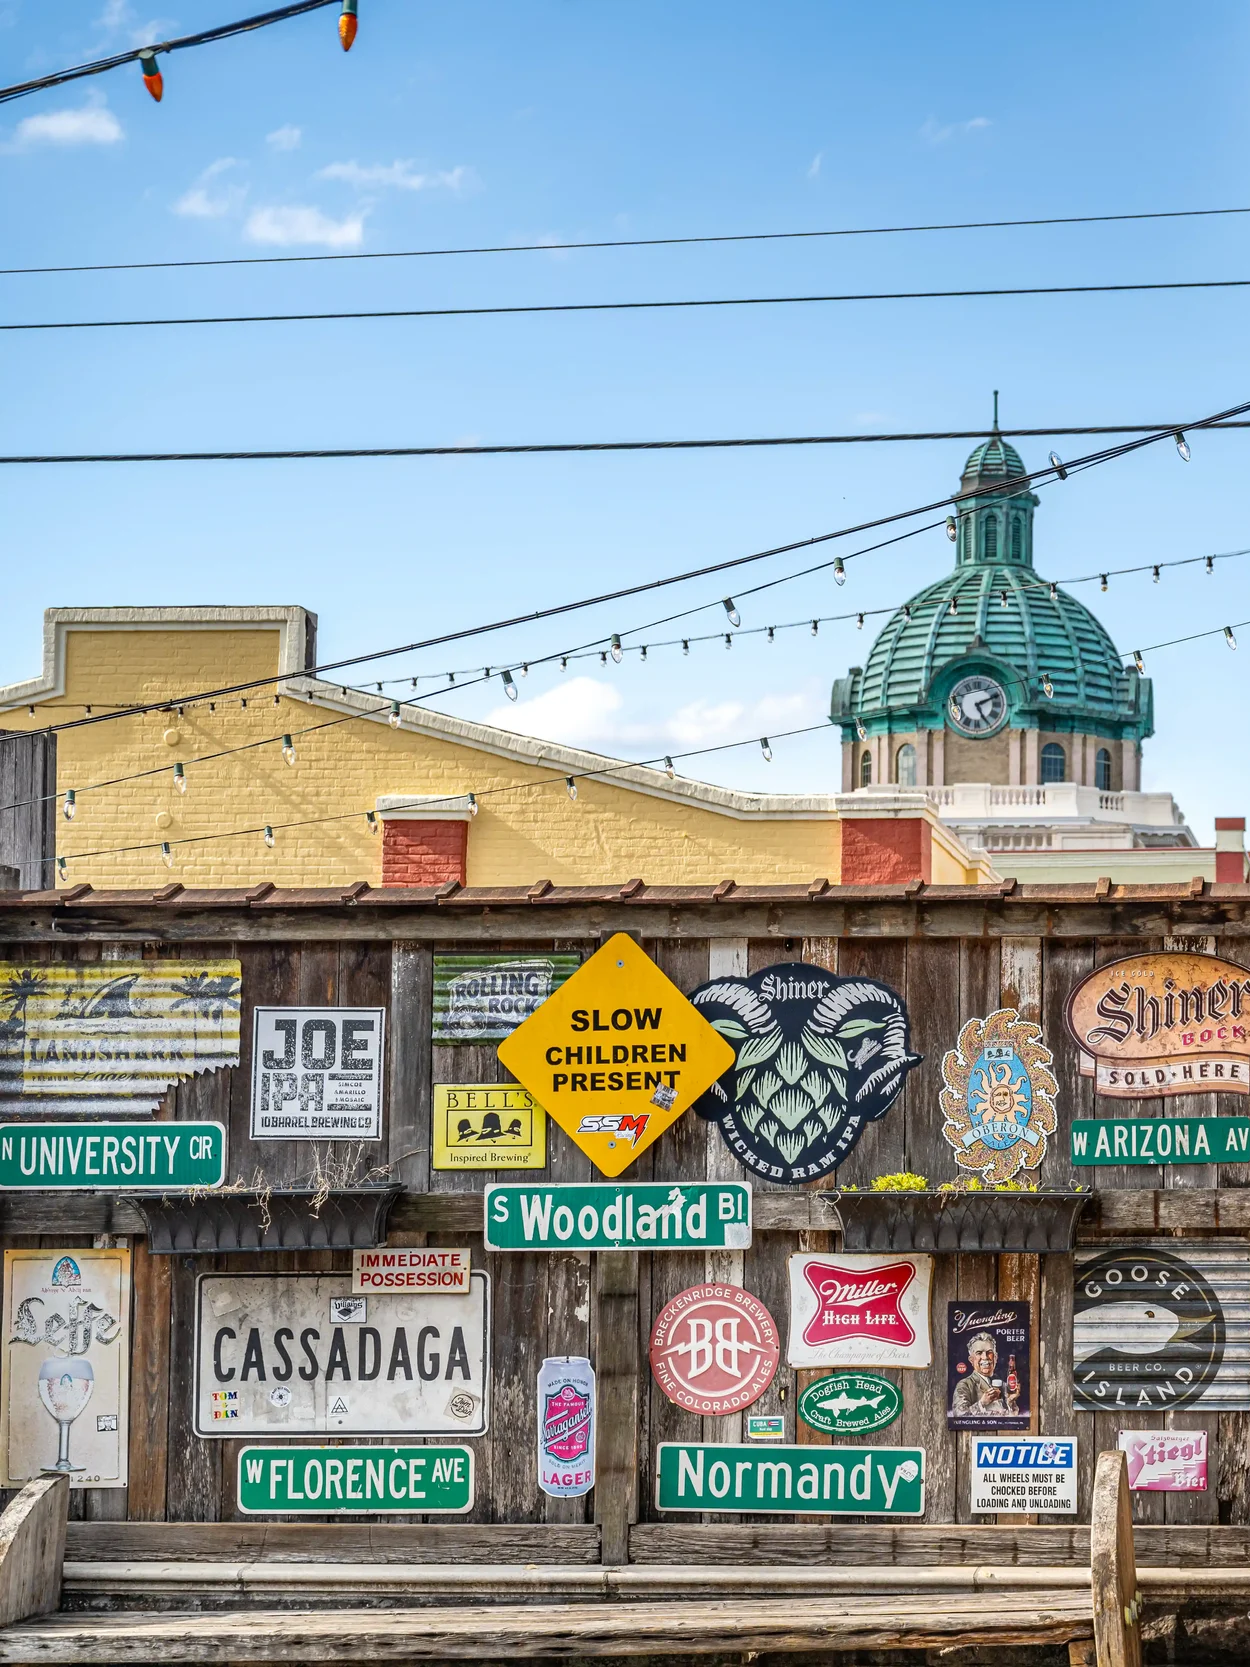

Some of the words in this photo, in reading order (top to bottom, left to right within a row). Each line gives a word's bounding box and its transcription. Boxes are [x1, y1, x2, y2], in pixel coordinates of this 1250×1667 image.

[455, 971, 539, 1000] ROLLING
[758, 974, 828, 1002] Shiner
[571, 1008, 662, 1031] SLOW
[262, 1019, 374, 1069] JOE
[1181, 1025, 1245, 1046] BOCK
[29, 1038, 188, 1062] LANDSHARK
[545, 1043, 686, 1066] CHILDREN
[73, 1070, 141, 1082] Lager
[553, 1070, 681, 1092] PRESENT
[1108, 1069, 1166, 1085] SOLD
[1182, 1063, 1240, 1080] HERE
[260, 1073, 324, 1111] IPA
[447, 1091, 534, 1108] BELL'S
[577, 1114, 650, 1140] SSM
[972, 1123, 1029, 1139] OBERON
[721, 1113, 784, 1179] WICKED
[791, 1152, 837, 1179] RAM
[838, 1114, 862, 1151] IPA
[1073, 1132, 1088, 1156] W
[1095, 1124, 1211, 1158] ARIZONA
[1225, 1127, 1249, 1151] AV
[2, 1139, 12, 1160] N
[20, 1136, 180, 1175] UNIVERSITY
[190, 1138, 213, 1159] CIR
[449, 1152, 487, 1163] Inspired
[490, 1152, 529, 1164] Brewing
[493, 1195, 509, 1222] S
[520, 1192, 707, 1241] Woodland
[361, 1254, 461, 1267] IMMEDIATE
[360, 1272, 464, 1286] POSSESSION
[1085, 1265, 1190, 1300] GOOSE
[820, 1280, 898, 1304] Miller
[654, 1287, 732, 1346] BRECKENRIDGE
[734, 1292, 775, 1345] BREWERY
[822, 1311, 860, 1326] HIGH
[953, 1309, 1018, 1333] Yuengling
[213, 1326, 471, 1382] CASSADAGA
[808, 1348, 827, 1359] The
[828, 1348, 874, 1362] Champagne
[885, 1348, 911, 1359] Beers
[1109, 1363, 1140, 1372] BEER
[1145, 1363, 1166, 1371] CO.
[212, 1391, 238, 1401] TOM
[656, 1362, 676, 1391] FINE
[677, 1390, 750, 1410] COLORADO
[752, 1359, 773, 1393] ALES
[809, 1380, 850, 1402] Dogfish
[855, 1380, 883, 1394] Head
[1082, 1367, 1193, 1406] ISLAND
[214, 1410, 239, 1419] DAN
[810, 1409, 832, 1425] Craft
[836, 1416, 869, 1428] Brewed
[874, 1406, 891, 1421] Ales
[1126, 1436, 1203, 1487] Stiegl
[246, 1459, 263, 1483] W
[270, 1458, 425, 1500] FLORENCE
[432, 1458, 464, 1483] AVE
[543, 1470, 591, 1486] LAGER
[677, 1449, 901, 1509] Normandy
[983, 1473, 996, 1483] ALL
[999, 1473, 1030, 1483] WHEELS
[1032, 1473, 1053, 1483] MUST
[1056, 1474, 1065, 1483] BE
[1171, 1472, 1206, 1487] Bier
[991, 1486, 1026, 1495] CHOCKED
[1028, 1486, 1057, 1496] BEFORE
[977, 1498, 1009, 1508] LOADING
[1011, 1499, 1027, 1508] AND
[1029, 1499, 1071, 1508] UNLOADING
